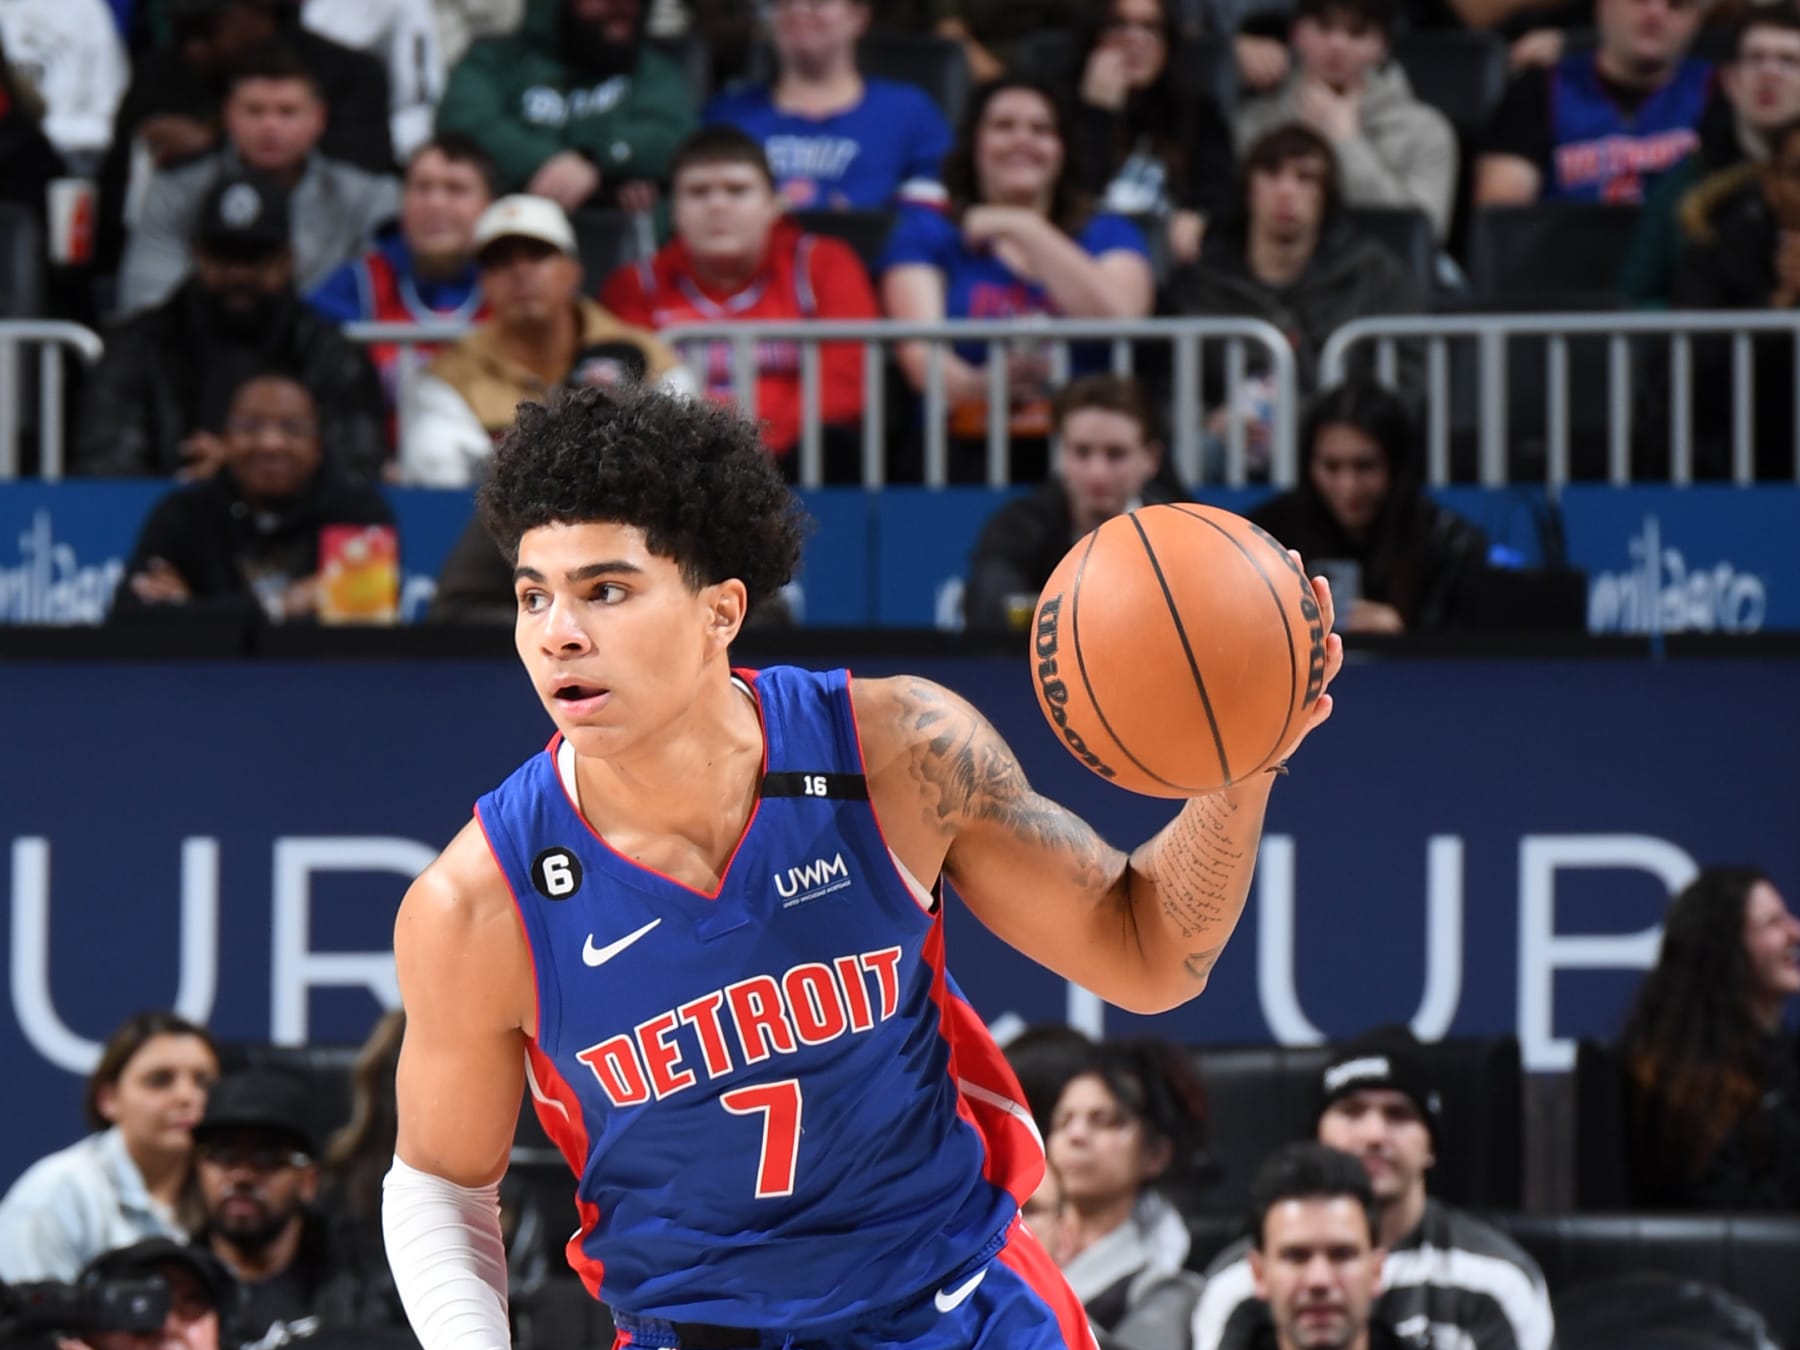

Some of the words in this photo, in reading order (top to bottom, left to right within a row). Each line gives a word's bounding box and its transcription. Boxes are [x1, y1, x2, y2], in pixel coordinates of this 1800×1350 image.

[804, 775, 828, 797] 16
[542, 853, 575, 896] 6
[774, 852, 849, 898] UWM
[575, 945, 902, 1107] DETROIT
[719, 1078, 803, 1200] 7
